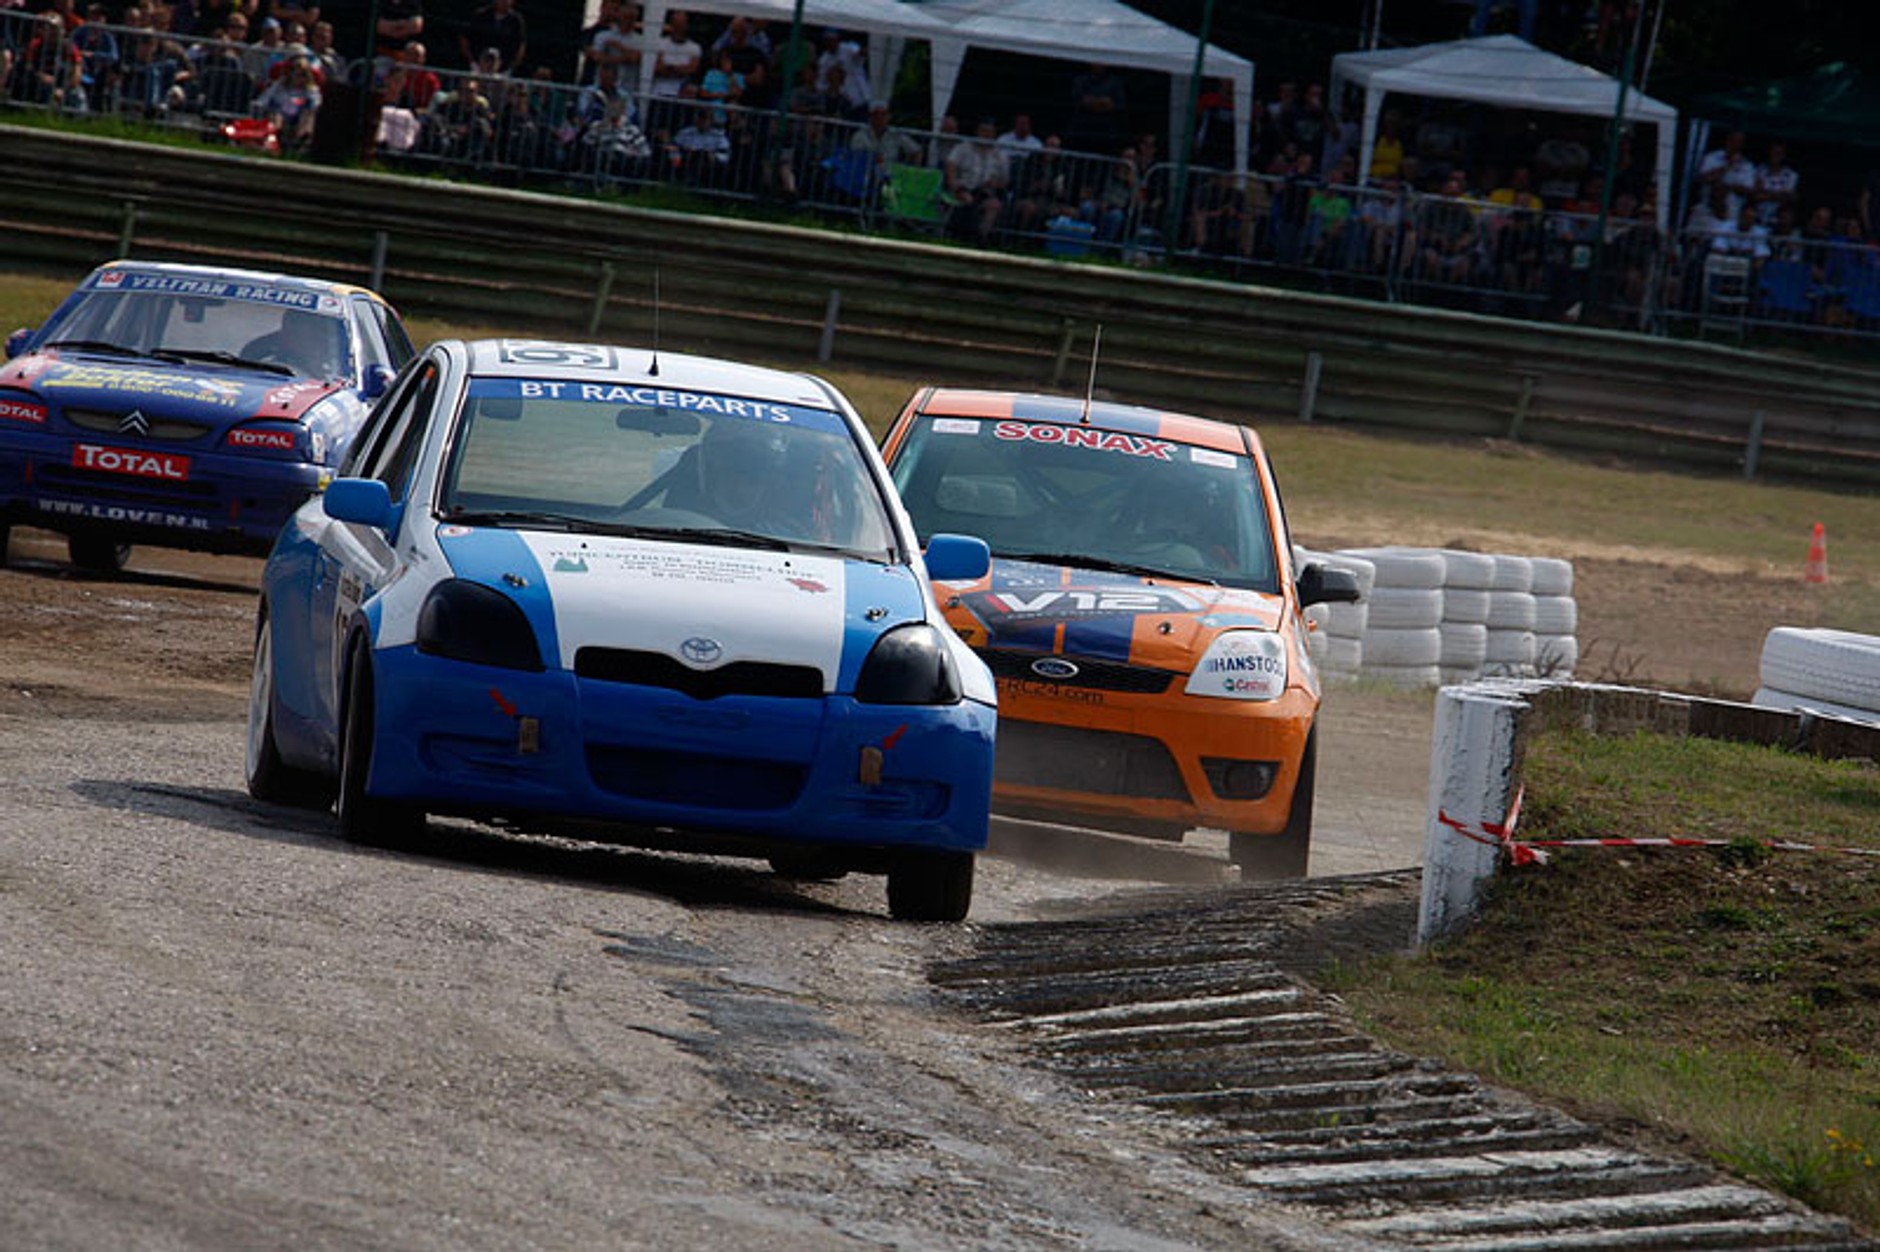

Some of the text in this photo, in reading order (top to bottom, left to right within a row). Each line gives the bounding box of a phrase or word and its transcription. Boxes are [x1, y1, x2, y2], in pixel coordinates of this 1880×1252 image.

[131, 275, 314, 308] VELTMAN RACING
[520, 381, 792, 423] BT RACEPARTS
[231, 430, 293, 448] TOTAL
[994, 422, 1177, 461] SONAX
[79, 444, 183, 477] TOTAL
[996, 591, 1159, 612] V12
